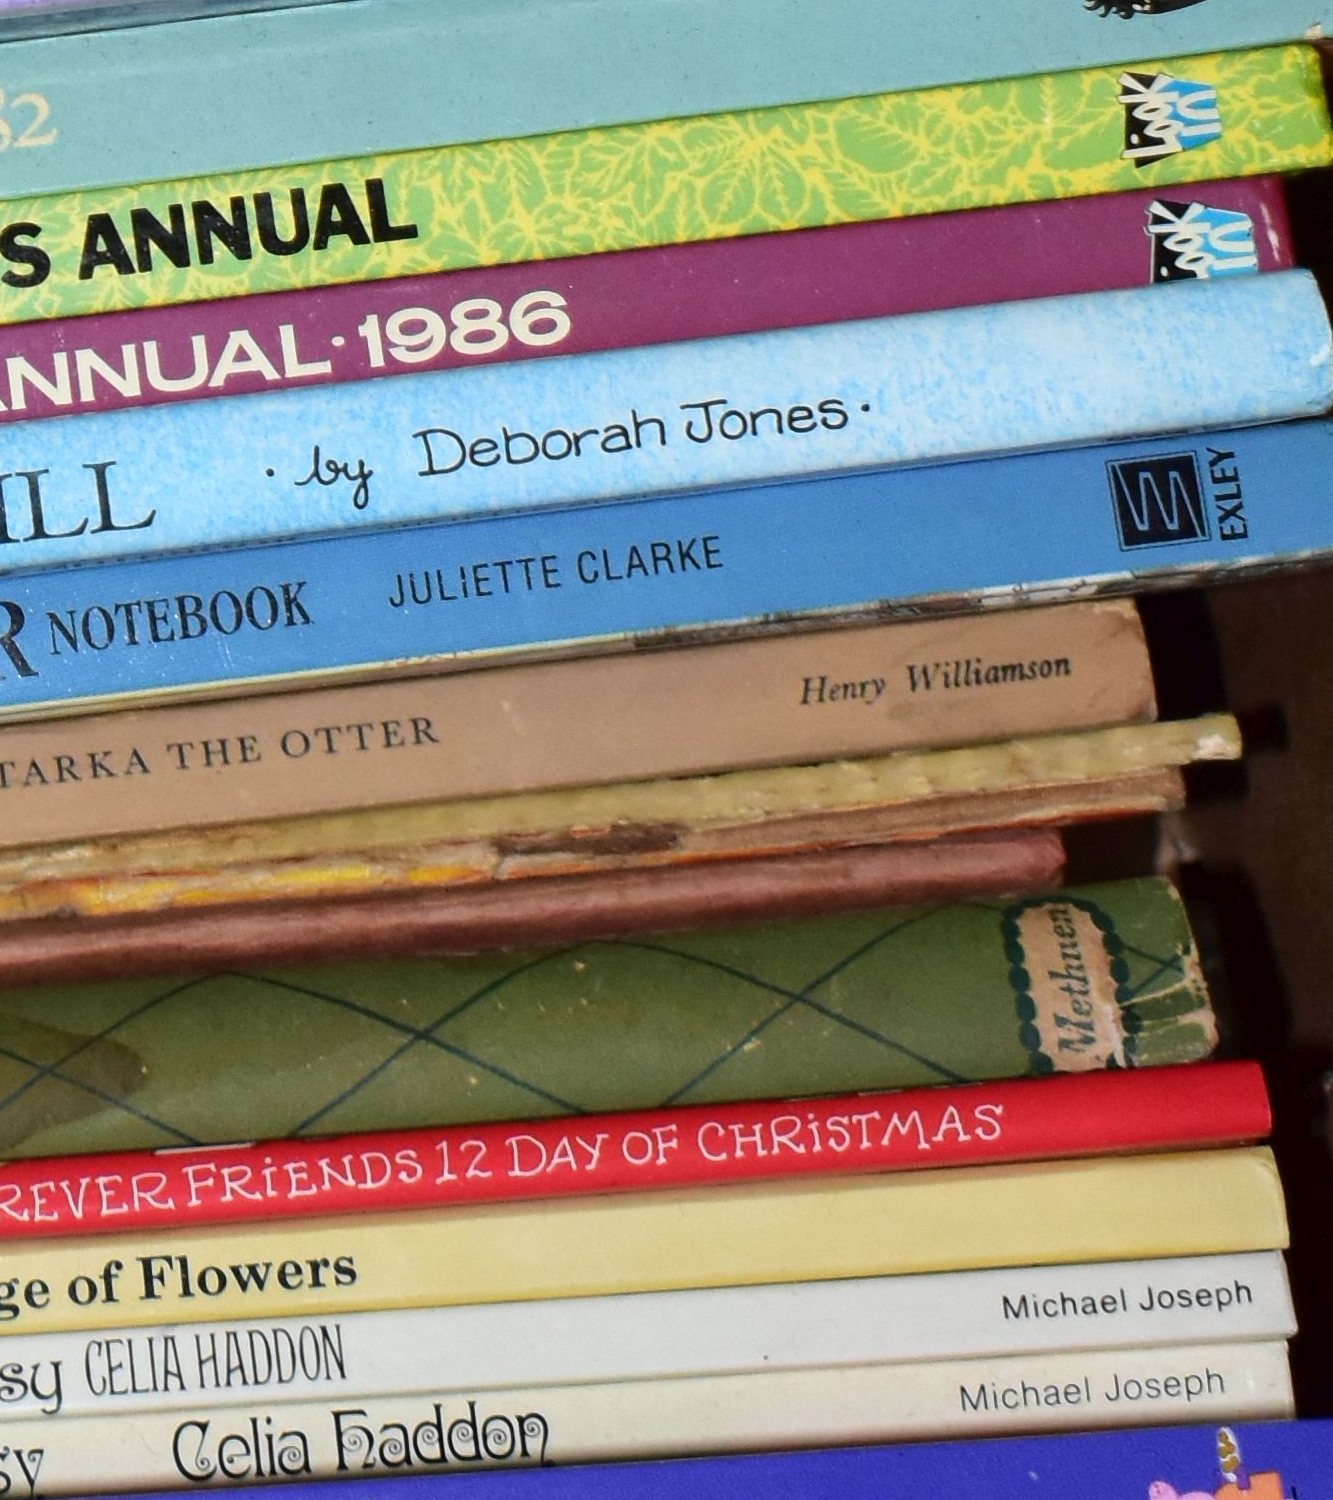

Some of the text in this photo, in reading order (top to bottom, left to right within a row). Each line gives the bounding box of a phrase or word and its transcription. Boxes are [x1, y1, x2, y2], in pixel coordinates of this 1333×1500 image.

[78, 178, 419, 279] ANNUAL
[296, 448, 374, 508] by
[414, 407, 668, 479] Deborah
[684, 394, 850, 446] Jones
[1215, 446, 1249, 542] EXLEY
[46, 579, 314, 657] NOTEBOOK
[387, 552, 564, 610] JULIETTE
[576, 535, 724, 586] CLARKE
[166, 730, 264, 771] THE
[278, 714, 442, 761] OTTER
[799, 672, 887, 706] Henry
[904, 651, 1073, 694] Williamson
[1047, 904, 1096, 1055] Methuen
[184, 1150, 425, 1207] FRIENDS
[434, 1141, 486, 1181] 12
[505, 1133, 607, 1178] DAY
[624, 1126, 677, 1166] OF
[698, 1103, 1004, 1163] CHRISTMAS
[67, 1261, 124, 1304] of
[134, 1250, 357, 1299] Flowers
[84, 1334, 186, 1395] CELIA
[194, 1324, 347, 1386] HADDON
[1001, 1288, 1128, 1321] Michael
[1138, 1281, 1254, 1314] Joseph
[171, 1417, 309, 1481] Celia
[959, 1376, 1090, 1412] Michael
[1104, 1368, 1225, 1403] Joseph
